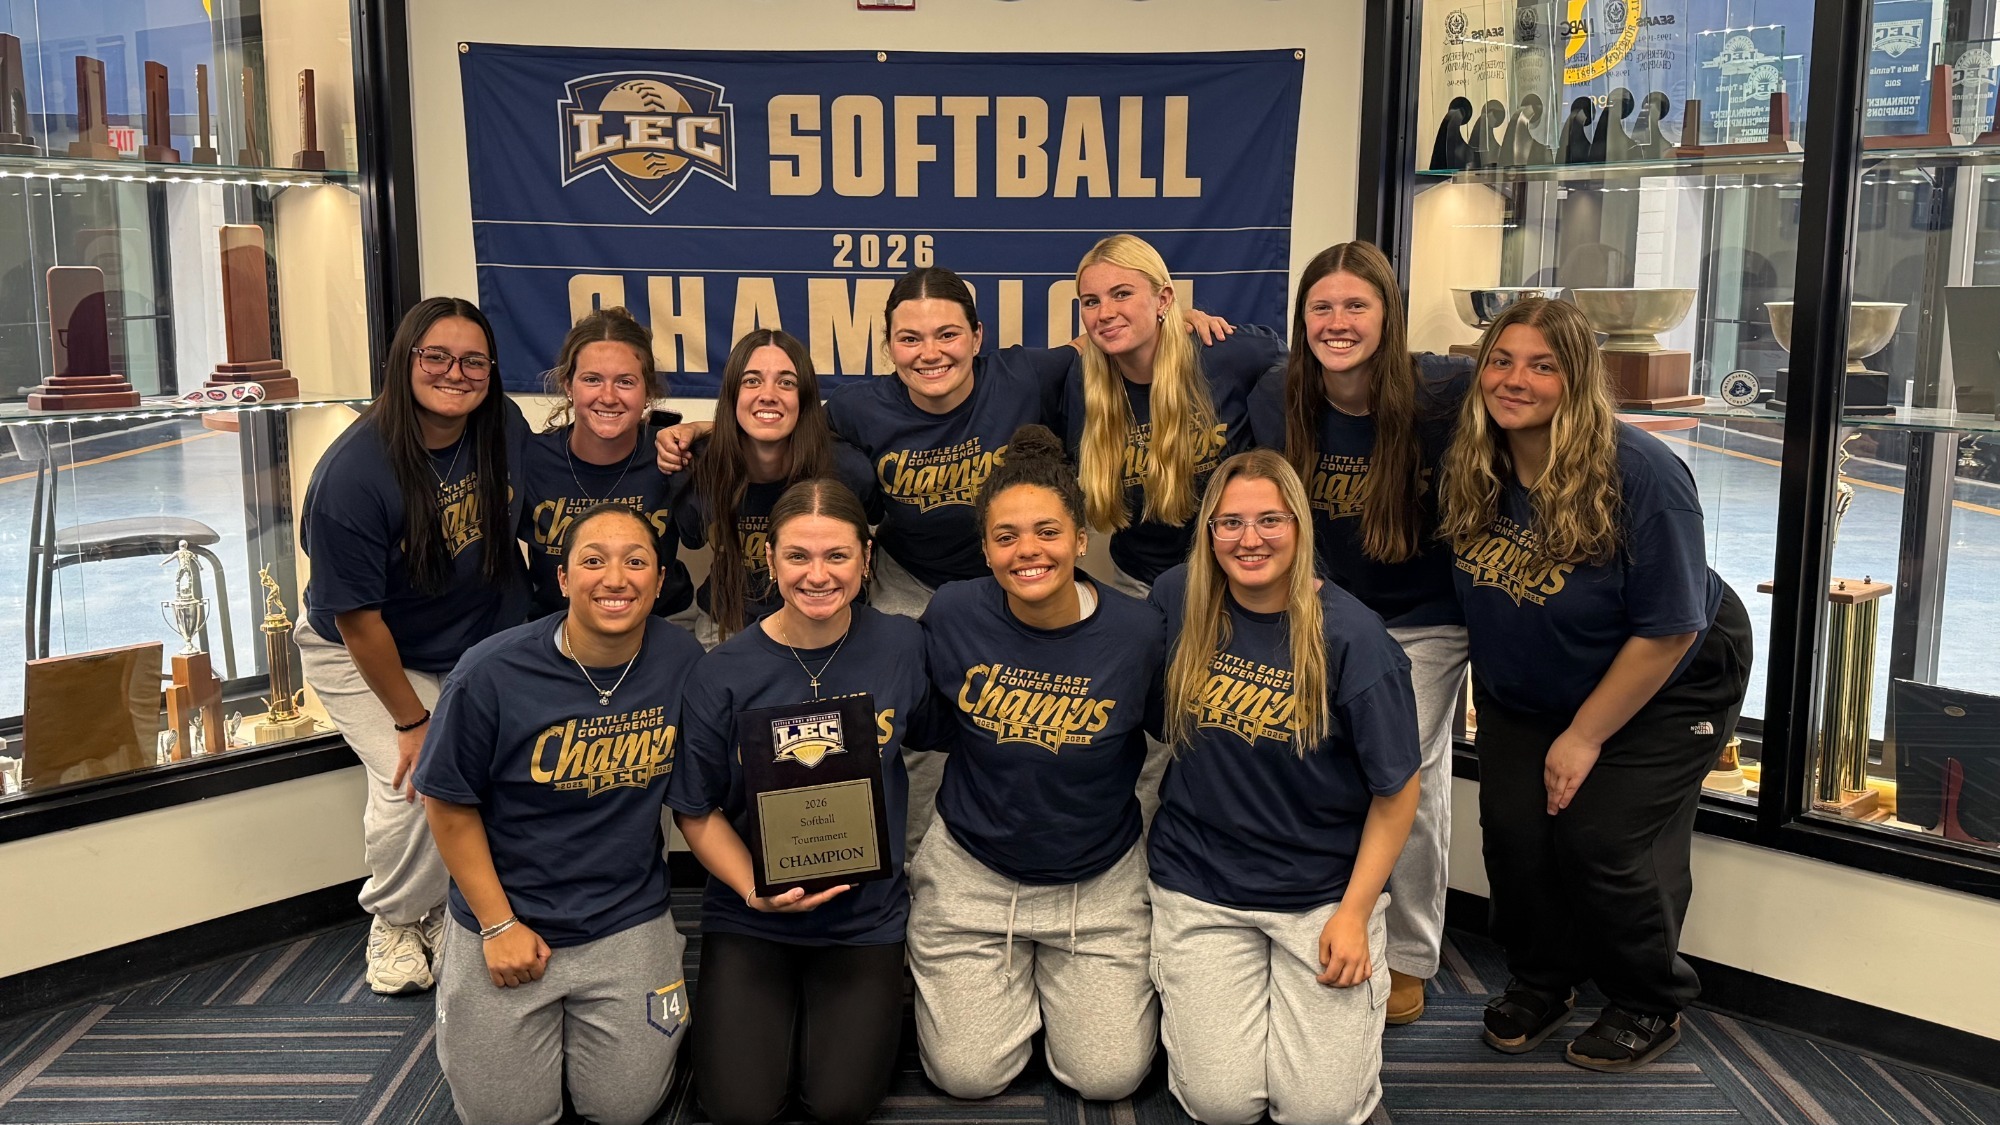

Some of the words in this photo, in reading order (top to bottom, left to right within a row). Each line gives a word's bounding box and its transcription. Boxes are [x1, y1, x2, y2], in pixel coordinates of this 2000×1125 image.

[108, 130, 134, 151] EXIT
[572, 114, 722, 166] LEC
[768, 94, 1202, 198] SOFTBALL
[833, 234, 934, 268] 2026
[908, 445, 981, 466] CONFERENCE
[912, 446, 951, 458] LITTLE
[952, 437, 980, 452] EAST
[1320, 462, 1369, 472] CONFER
[1323, 454, 1365, 464] LITTLE
[1477, 565, 1520, 596] LEC
[1005, 666, 1051, 682] LITTLE
[1054, 674, 1091, 686] EAST
[1209, 661, 1292, 690] ONFERENCE
[1258, 665, 1294, 680] EAST
[1000, 675, 1089, 696] CONFERENCE
[958, 664, 1116, 733] Champs
[578, 716, 664, 738] CONFERENCE
[582, 713, 628, 728] LITTLE
[631, 706, 664, 720] EAST
[1201, 706, 1253, 742] LEC
[777, 722, 839, 747] LEC
[976, 719, 995, 729] 2025
[1001, 722, 1057, 749] LEC
[1064, 734, 1086, 743] 2026
[530, 719, 677, 783] Champ
[560, 780, 583, 789] 2025
[592, 767, 647, 792] LEC
[805, 798, 827, 809] 2026
[800, 814, 835, 827] Softball
[792, 832, 848, 846] Tournament
[779, 847, 864, 869] CHAMPION
[662, 992, 680, 1020] 14
